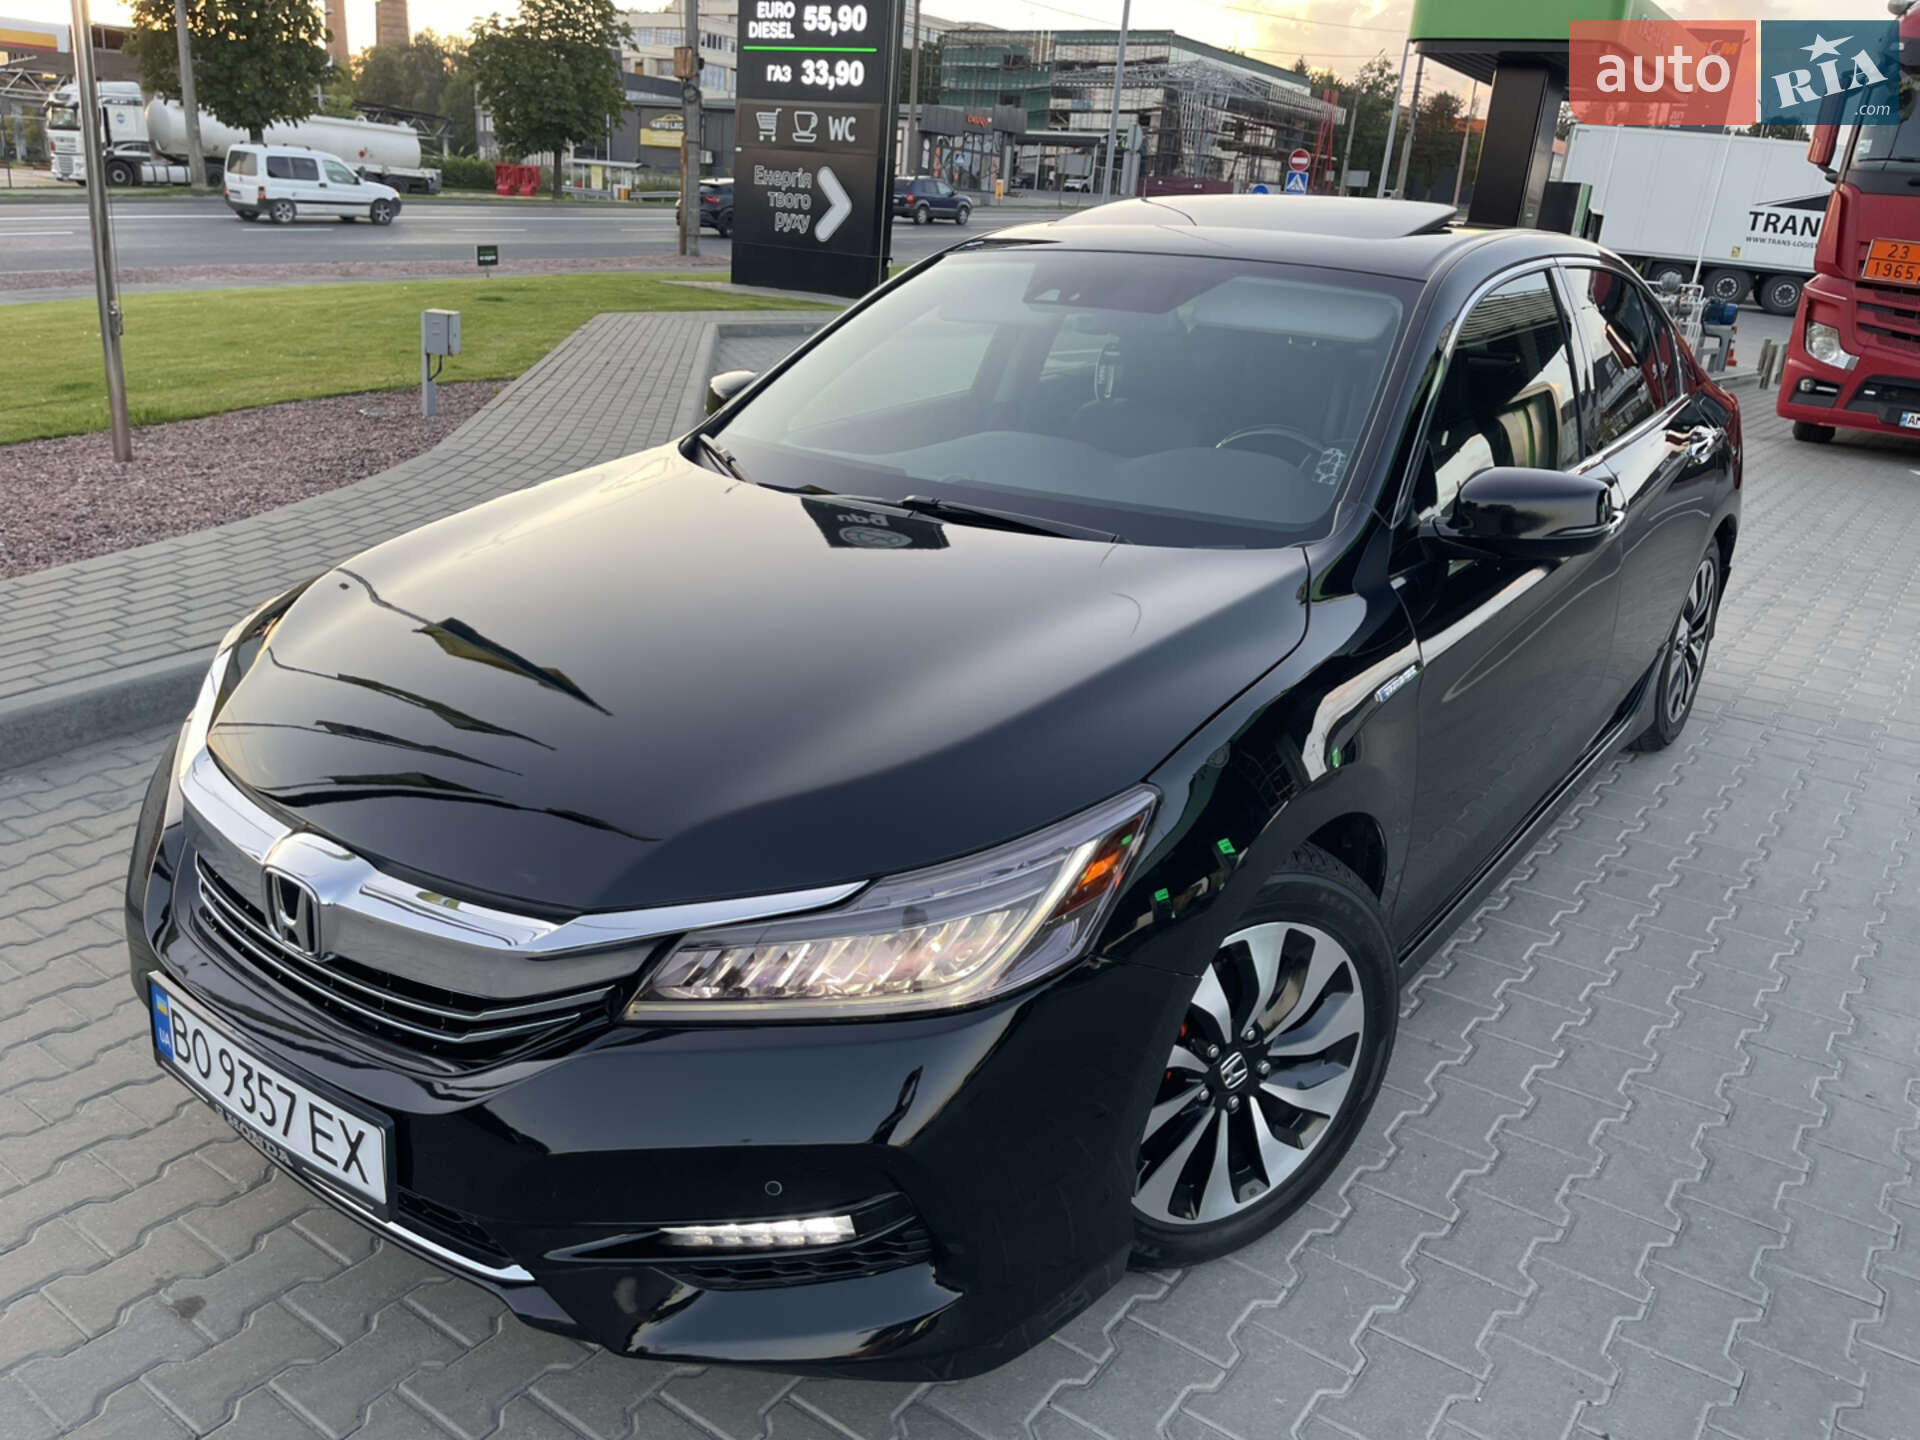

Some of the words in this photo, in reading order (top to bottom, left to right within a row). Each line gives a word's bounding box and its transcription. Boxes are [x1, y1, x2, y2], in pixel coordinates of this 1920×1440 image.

[757, 1, 795, 19] EURO
[803, 5, 868, 36] 55,90
[748, 21, 796, 39] DIESEL
[767, 64, 792, 82] ГАЗ
[800, 59, 865, 90] 33,90
[828, 116, 856, 142] WC
[754, 165, 813, 191] Енергія
[767, 191, 812, 210] твого
[774, 211, 811, 234] руху
[1888, 244, 1909, 260] 23
[1874, 261, 1914, 280] 1965
[171, 1007, 212, 1080] BO
[218, 1048, 297, 1138] 9357
[308, 1102, 370, 1185] EX
